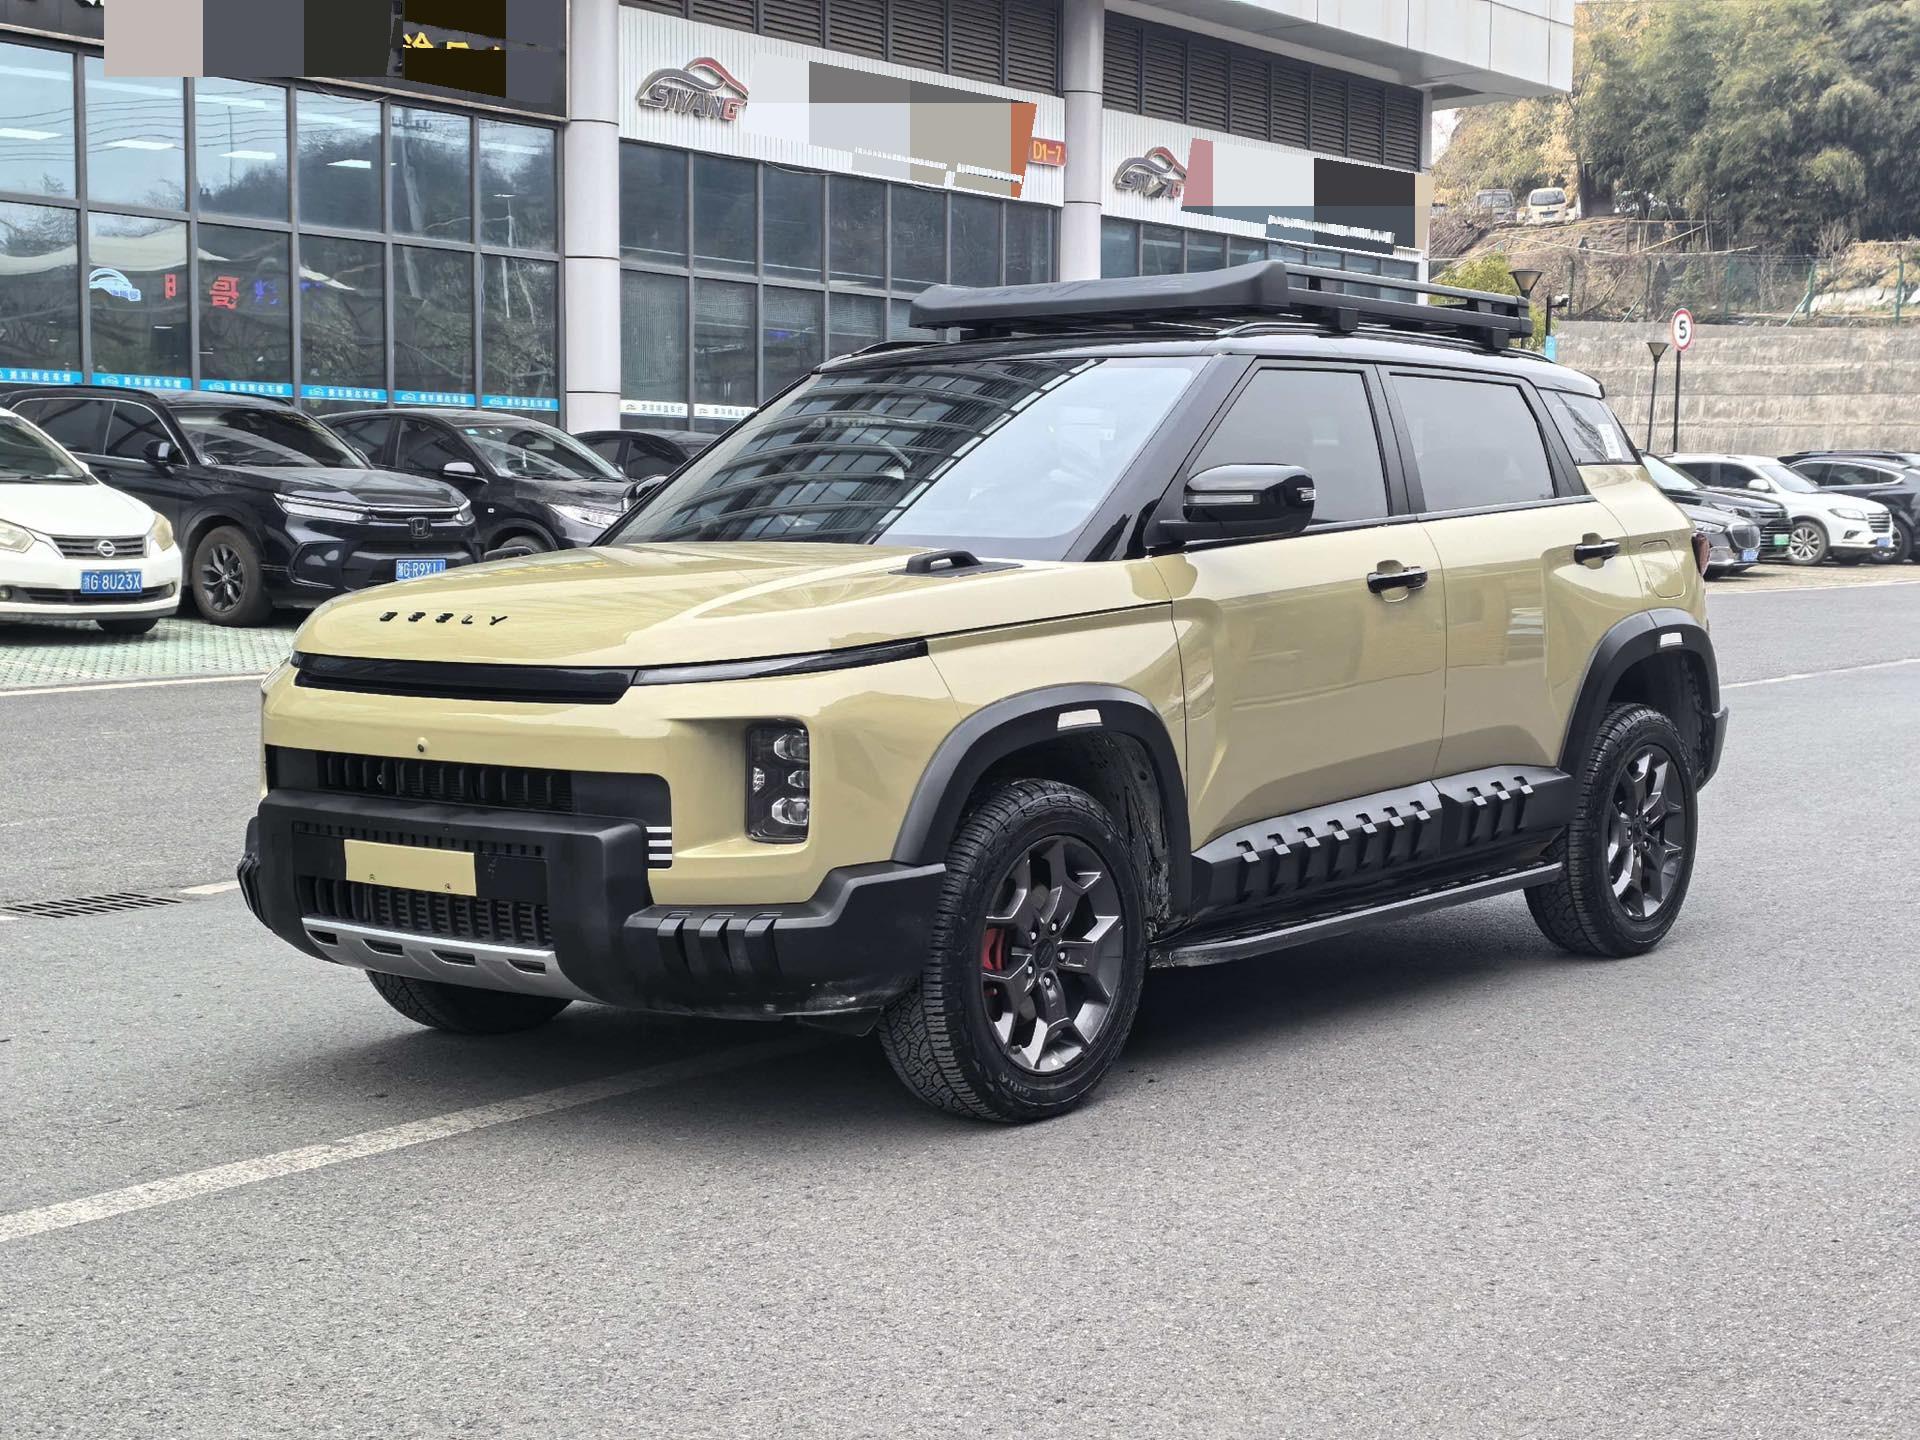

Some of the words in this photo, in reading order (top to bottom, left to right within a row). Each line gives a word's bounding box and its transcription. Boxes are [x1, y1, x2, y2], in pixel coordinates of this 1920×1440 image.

[640, 84, 748, 121] SIYANG
[1033, 140, 1062, 163] D1-7
[1679, 320, 1687, 339] 5
